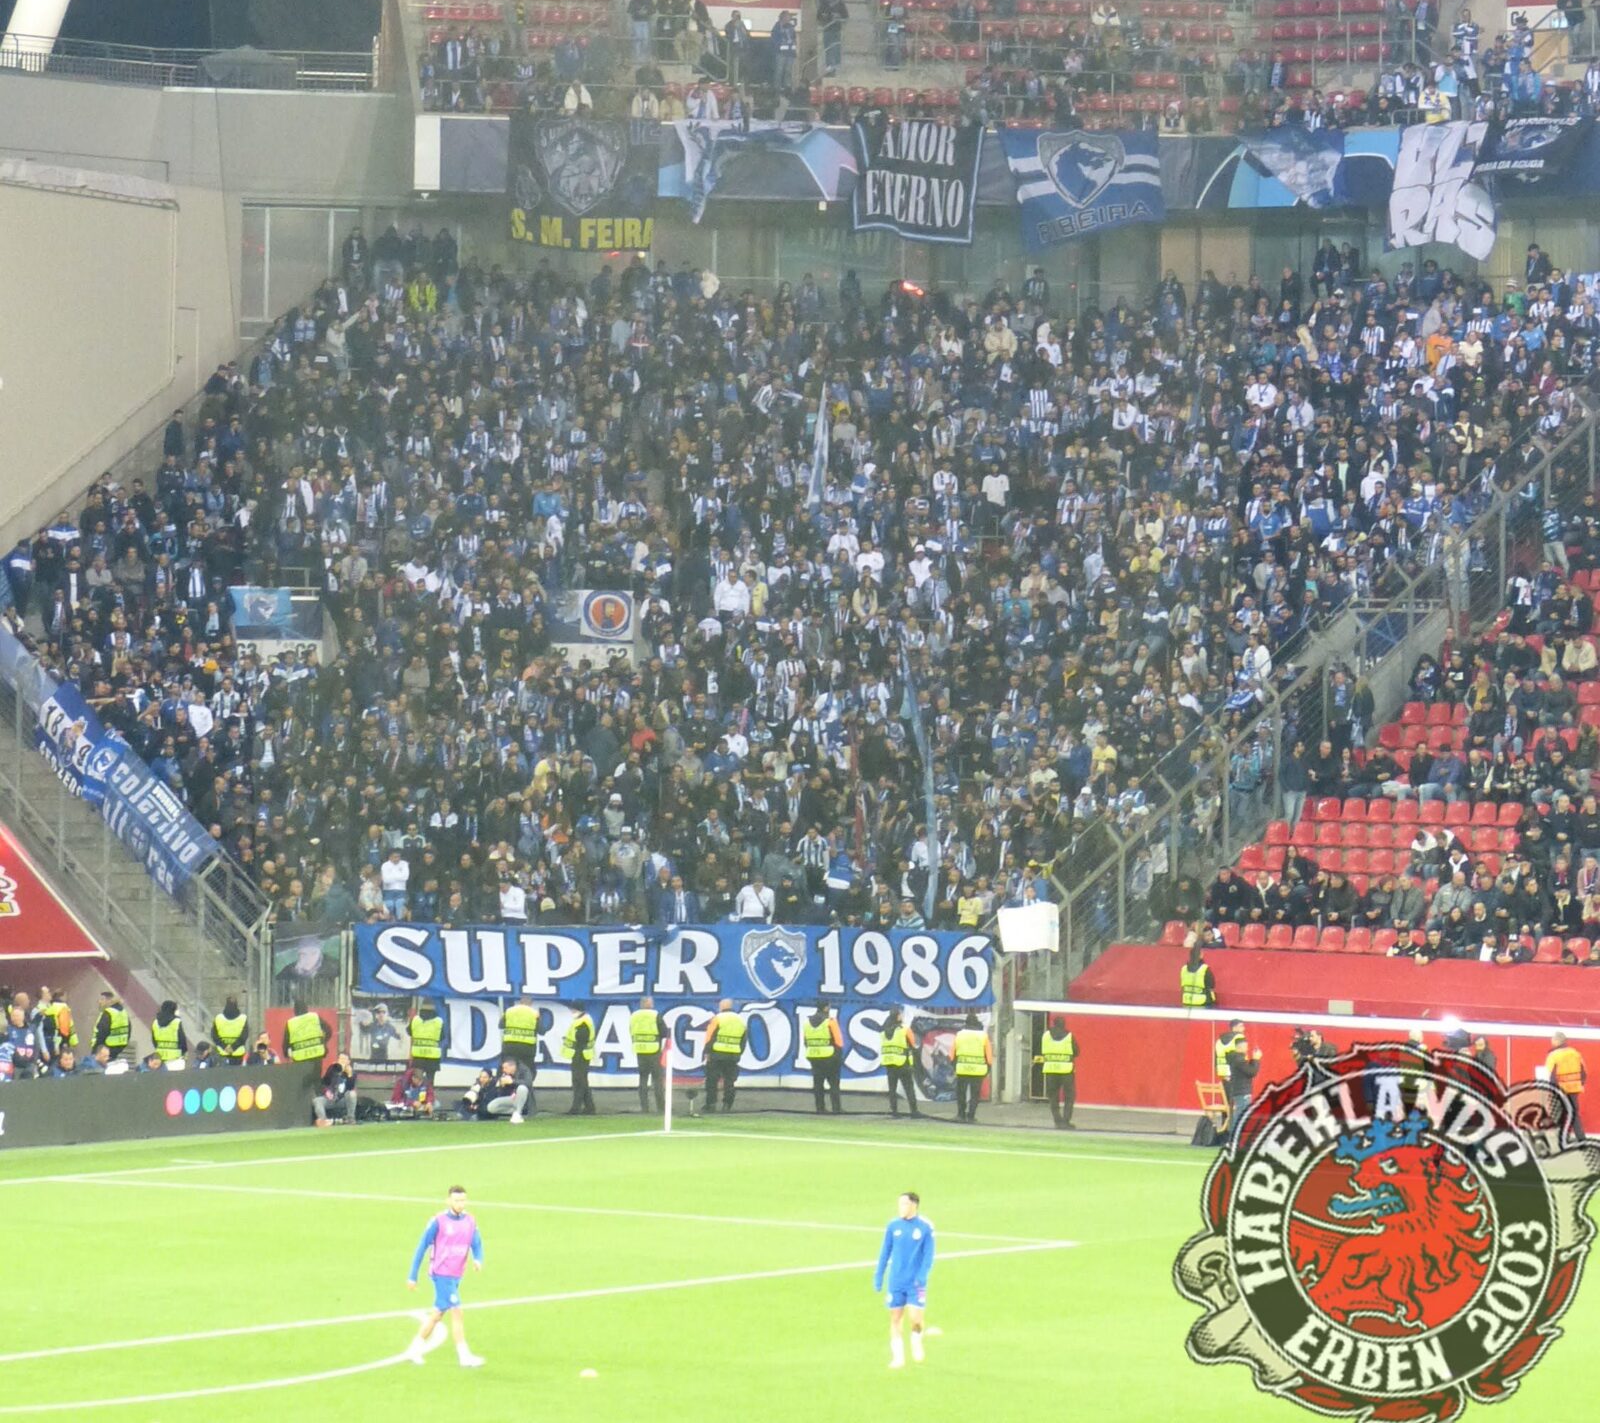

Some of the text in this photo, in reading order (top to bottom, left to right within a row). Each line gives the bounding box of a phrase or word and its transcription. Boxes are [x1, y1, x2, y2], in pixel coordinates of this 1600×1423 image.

[878, 121, 957, 166] AMOR
[866, 169, 965, 228] ETERNO
[511, 208, 655, 249] S. M. FEIRA
[1037, 200, 1153, 245] RIBEIRA
[375, 926, 991, 1001] SUPER 1986
